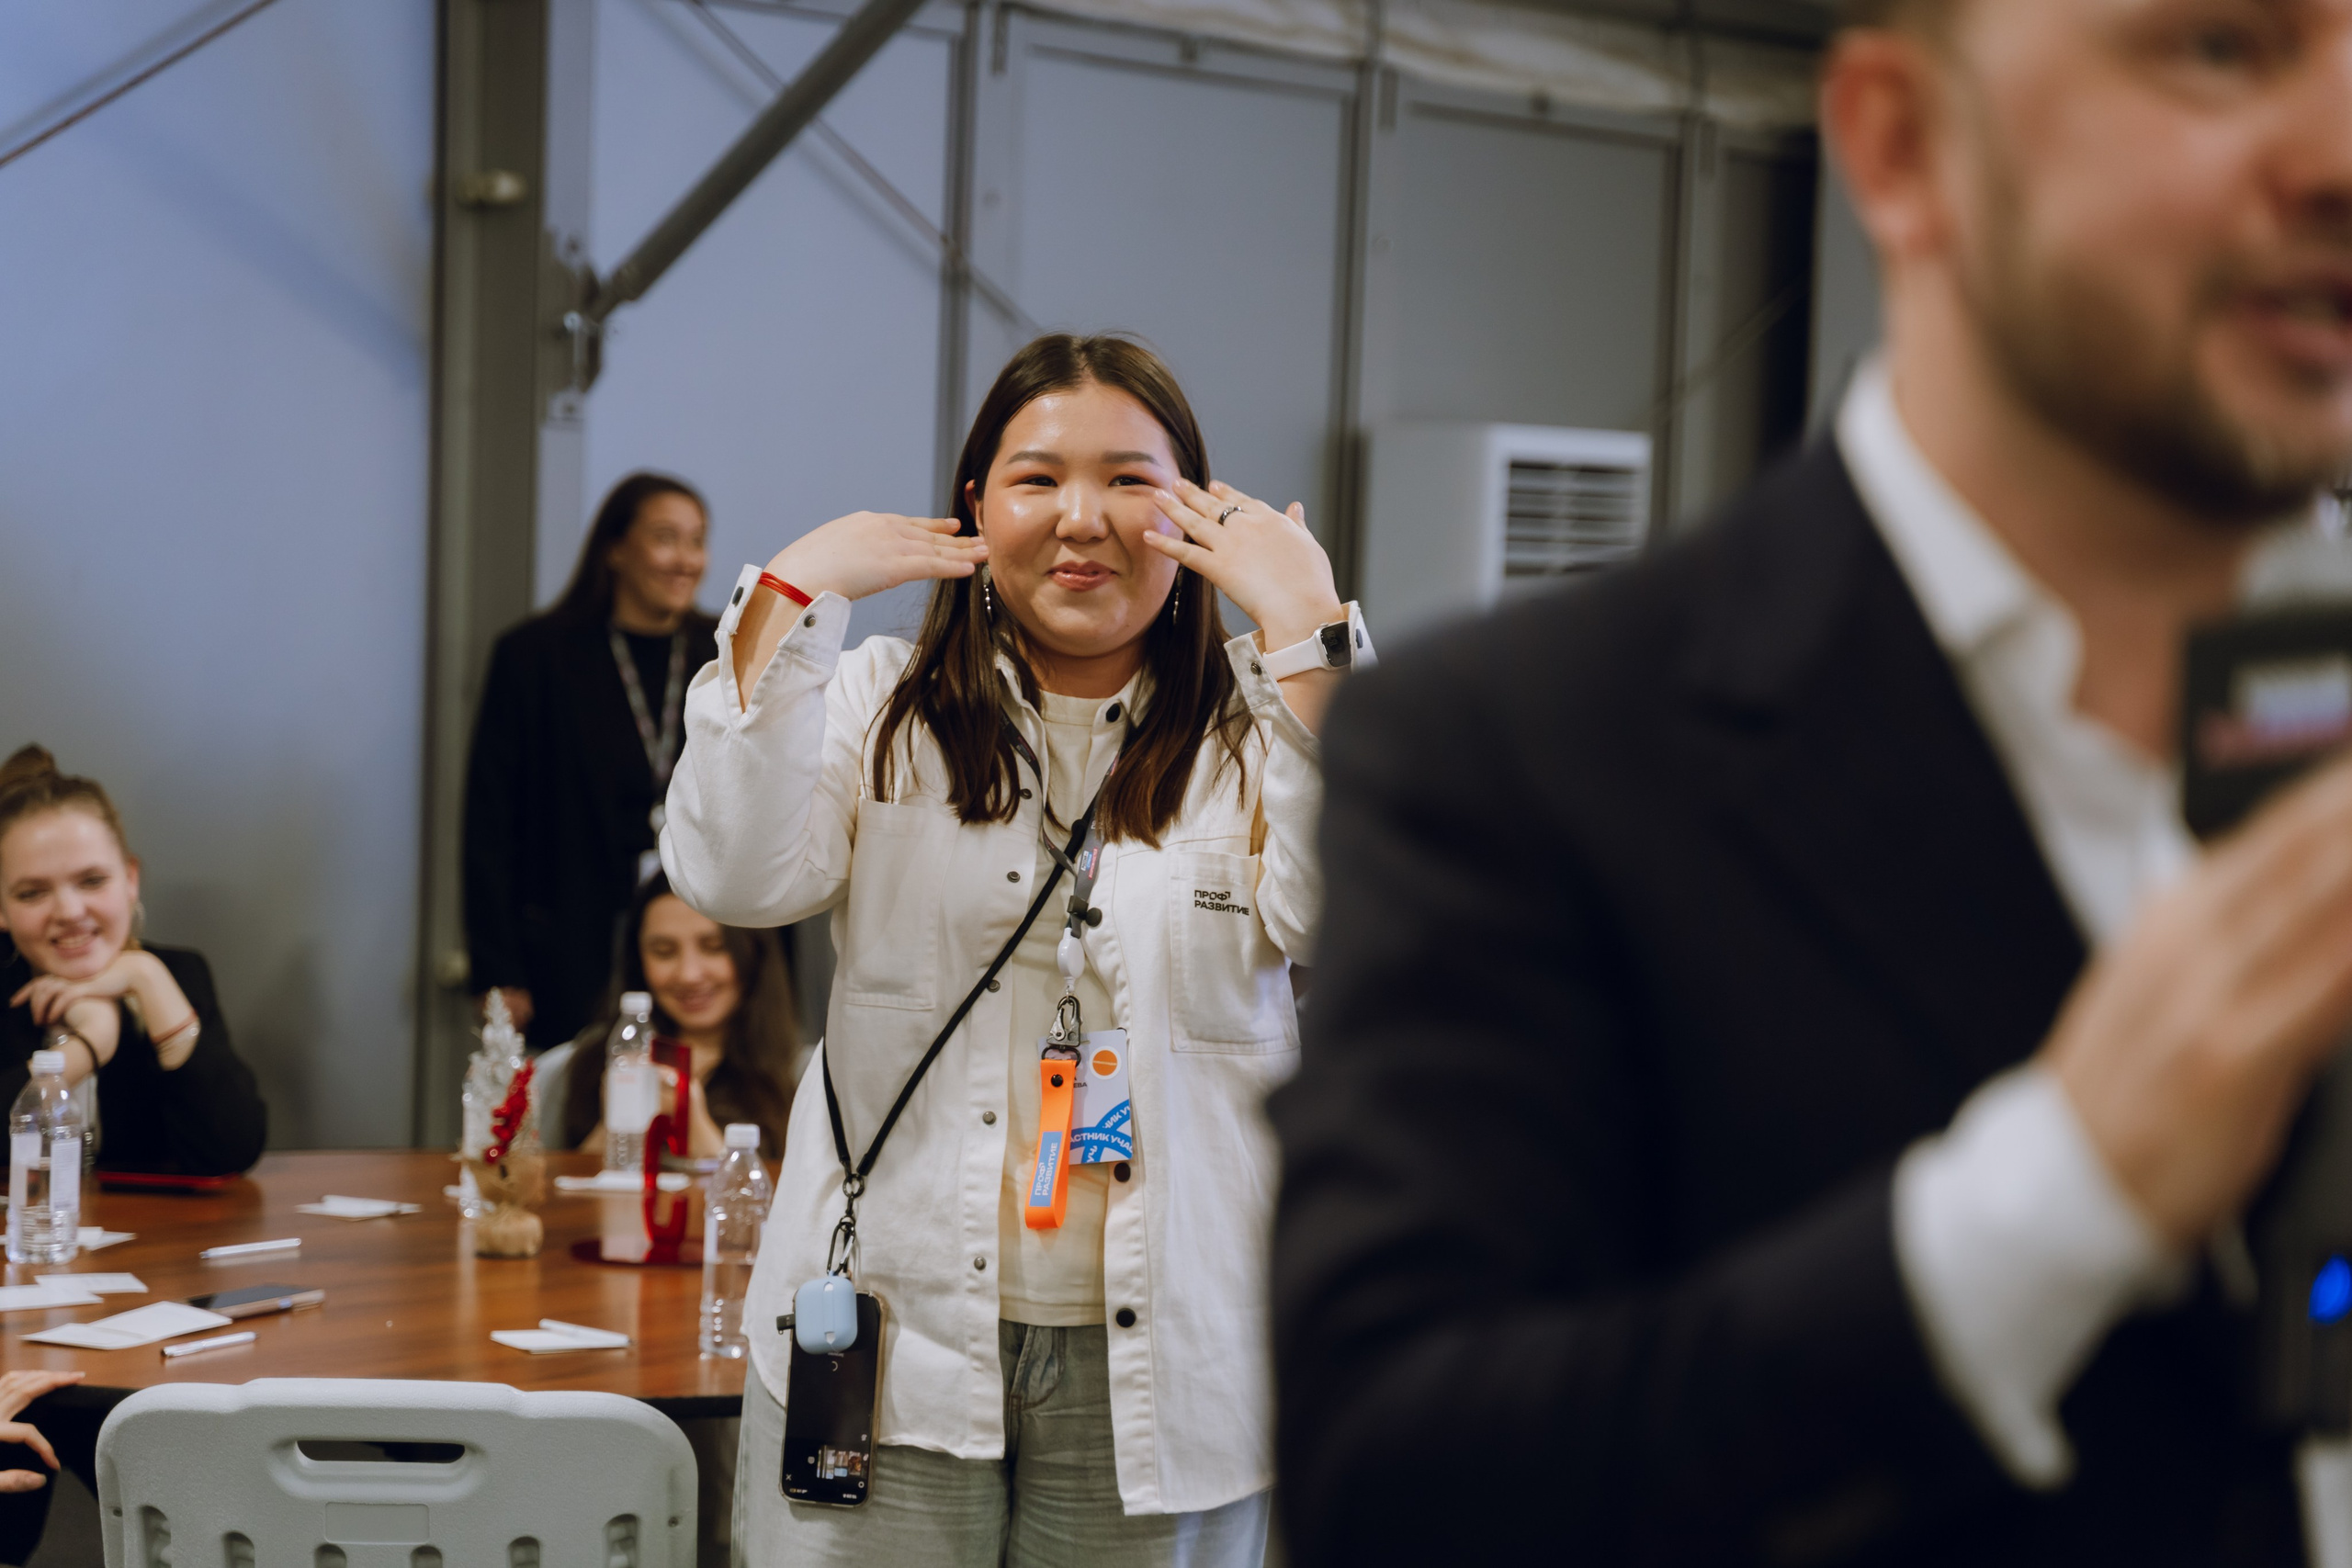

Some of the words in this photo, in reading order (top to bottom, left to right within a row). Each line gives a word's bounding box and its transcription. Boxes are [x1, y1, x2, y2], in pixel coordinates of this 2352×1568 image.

[1194, 889, 1228, 901] ПРОФ
[1193, 900, 1250, 916] РАЗВИТИЕ
[1035, 1164, 1046, 1196] ПРОФ
[1042, 1142, 1058, 1196] РАЗВИТИЕ
